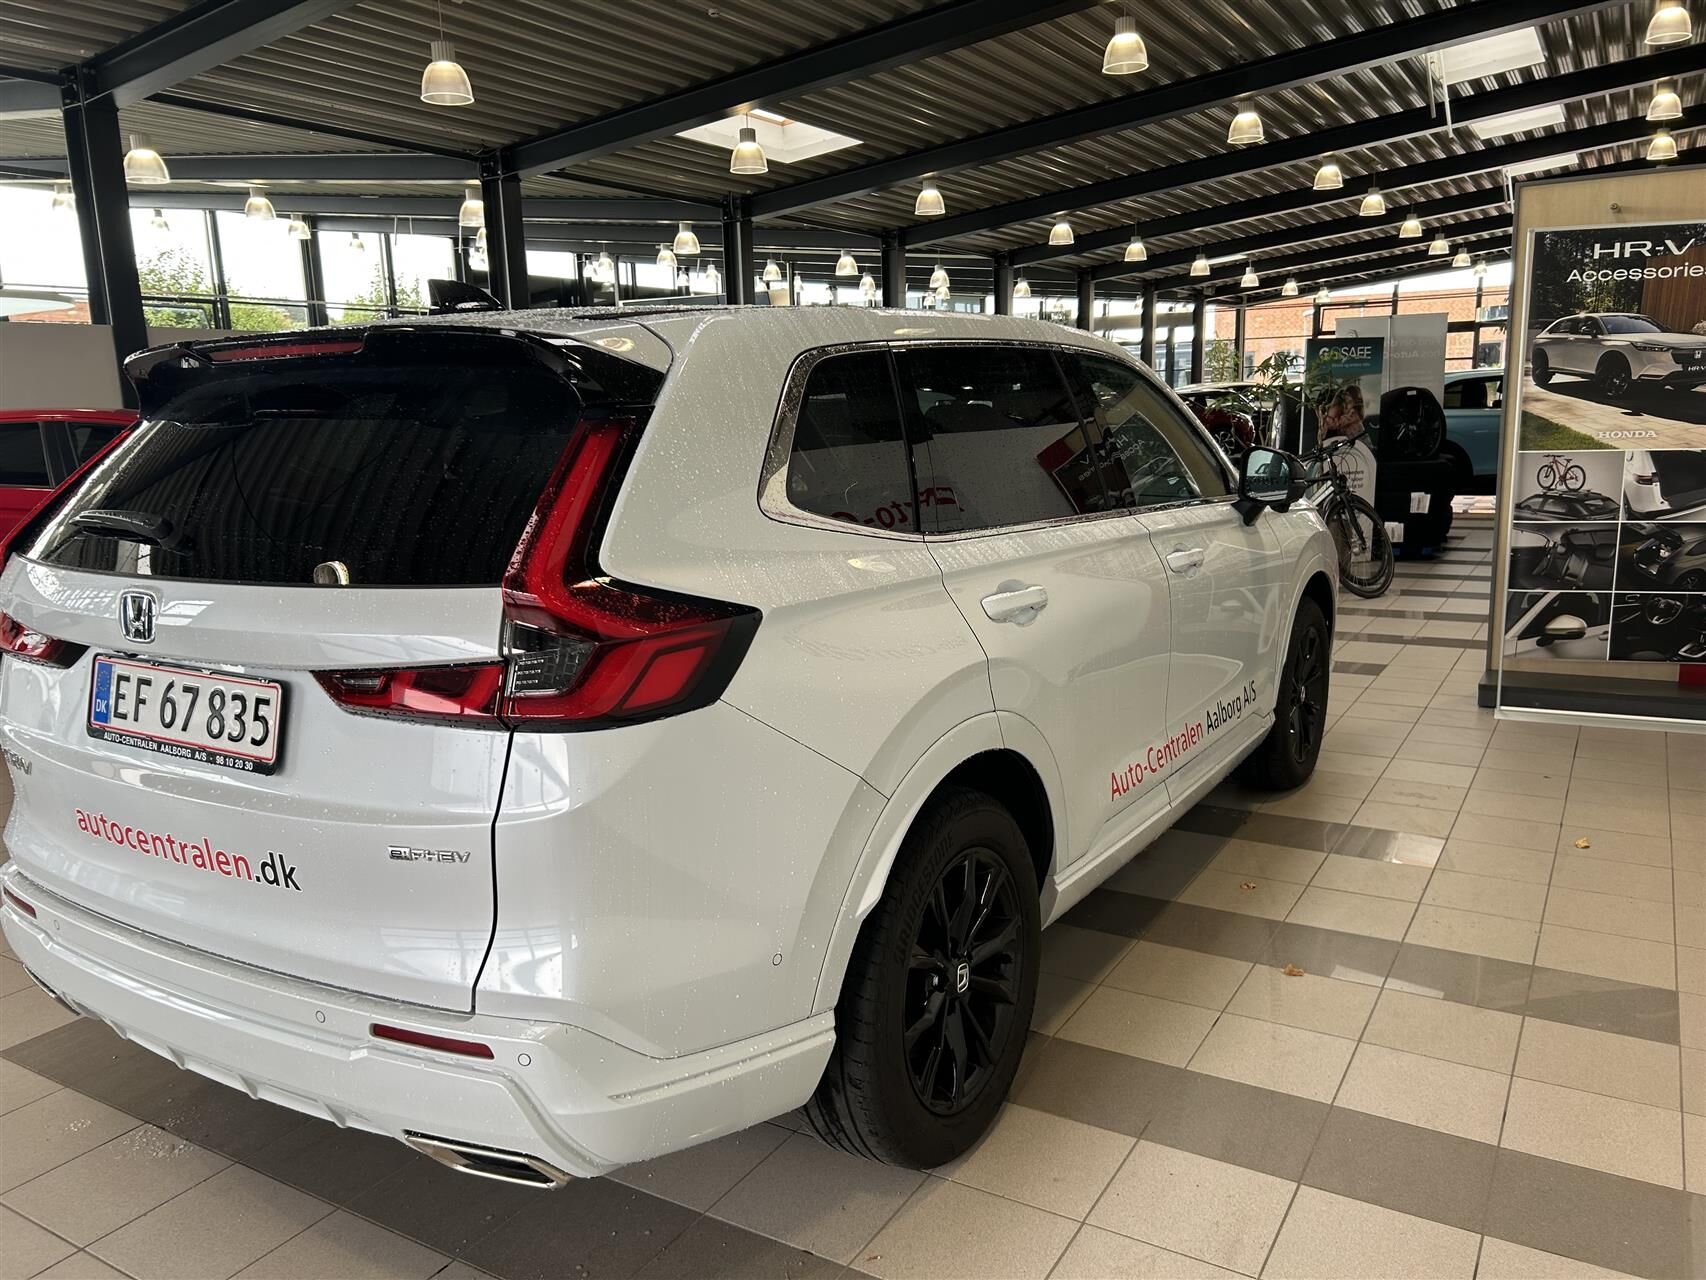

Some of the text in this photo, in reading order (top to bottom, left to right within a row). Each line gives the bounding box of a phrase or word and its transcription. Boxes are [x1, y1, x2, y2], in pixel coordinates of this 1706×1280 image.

[1593, 239, 1695, 259] HR-V
[1567, 263, 1706, 283] Accessorie
[1597, 429, 1657, 440] HONDA
[95, 698, 107, 714] DK
[113, 672, 271, 747] EF 67 835
[103, 732, 158, 751] AUTO-CENTRALEN
[160, 744, 192, 759] AALBORG
[194, 751, 207, 761] A/S
[225, 757, 234, 767] 10
[234, 760, 244, 770] 20
[244, 761, 254, 771] 30
[1110, 680, 1257, 802] Auto-Centralen Aalborg A/S
[75, 807, 302, 892] autocentralen.dk
